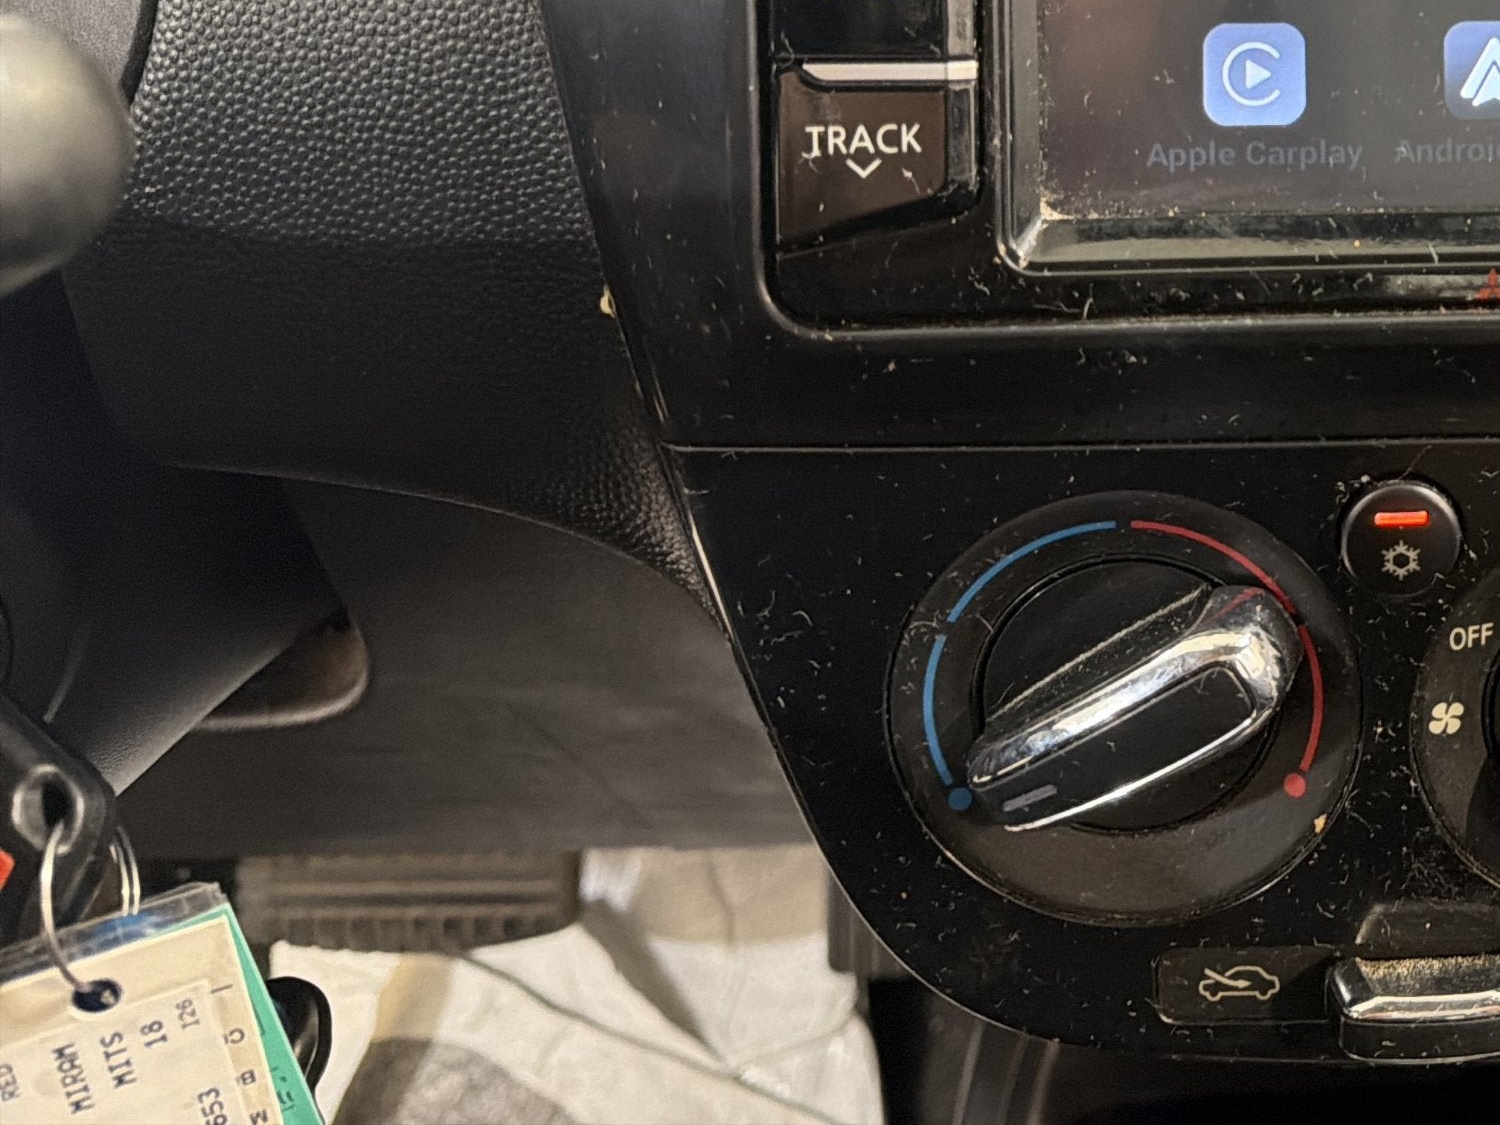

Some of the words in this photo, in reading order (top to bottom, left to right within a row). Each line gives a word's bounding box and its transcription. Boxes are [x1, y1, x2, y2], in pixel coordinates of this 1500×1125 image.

[805, 123, 922, 156] TRACK
[1146, 140, 1236, 173] Apple
[1246, 139, 1364, 173] Carplay
[1449, 622, 1494, 652] OFF
[139, 1020, 168, 1048] 18
[99, 1031, 138, 1089] MITS
